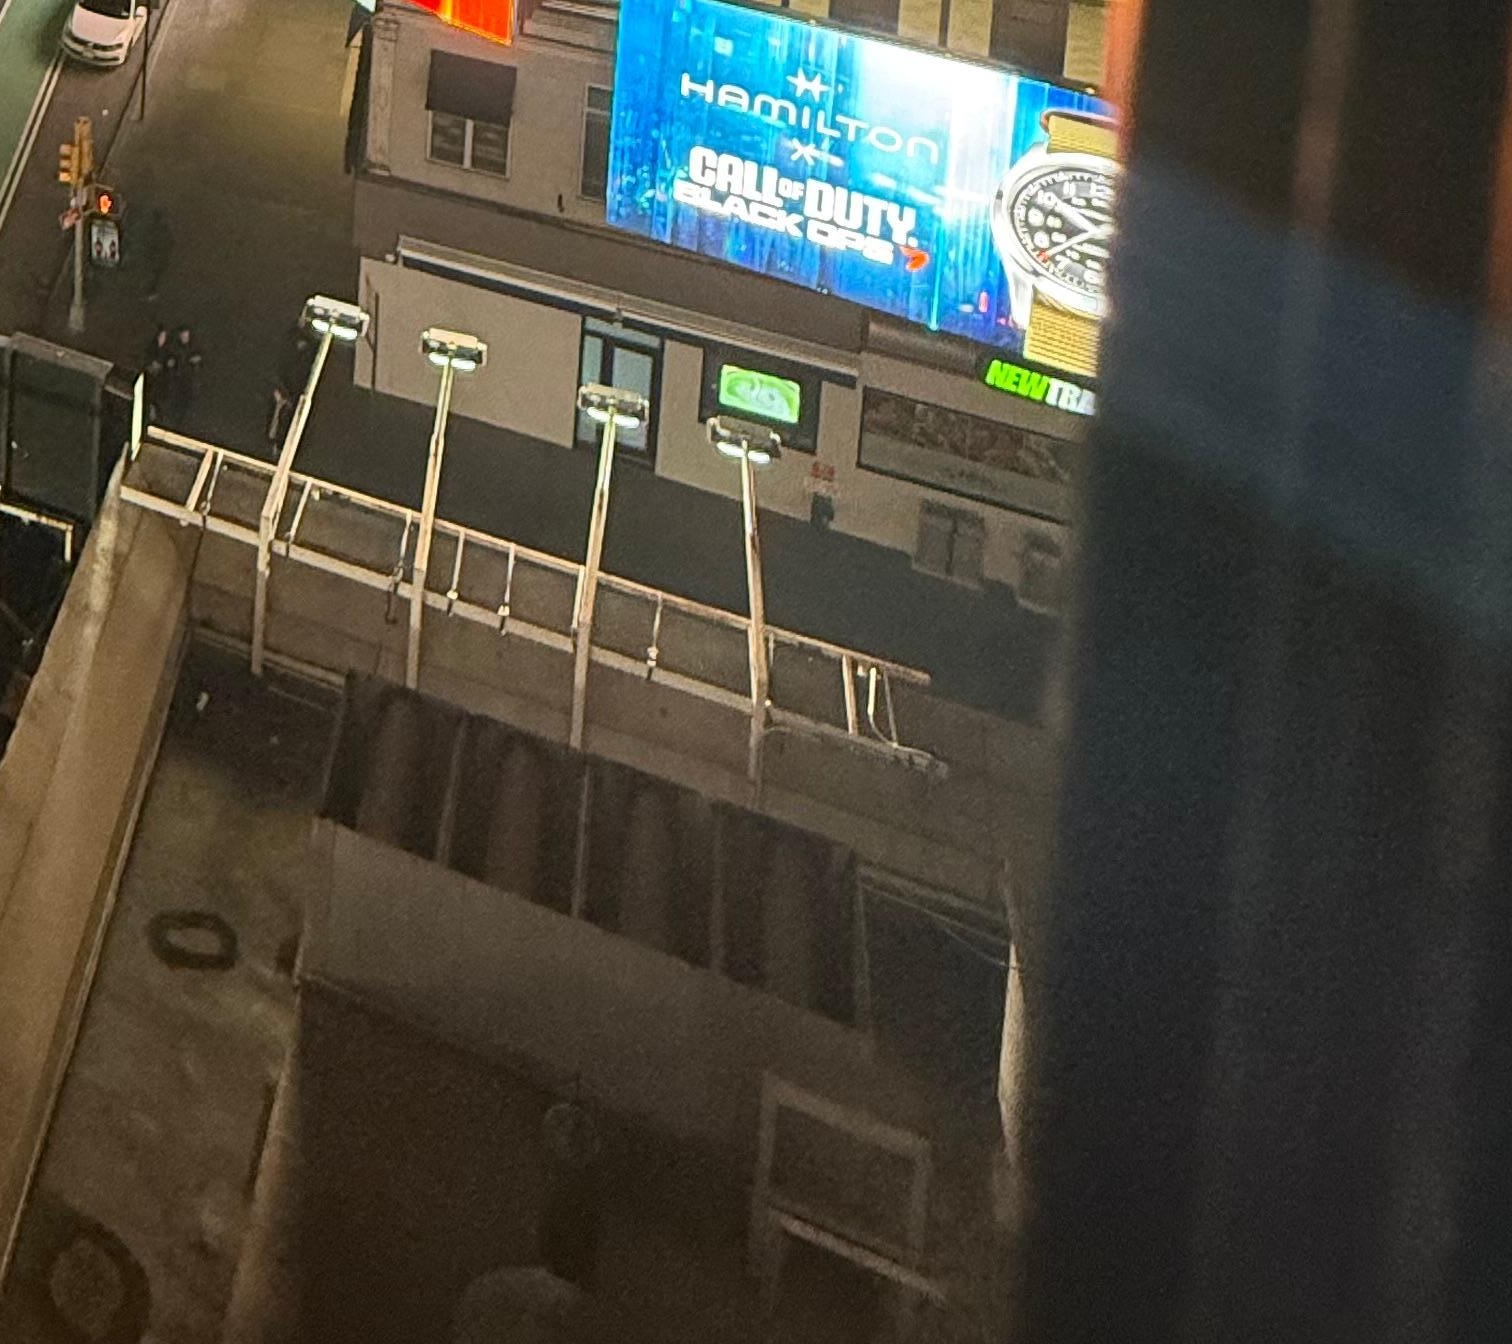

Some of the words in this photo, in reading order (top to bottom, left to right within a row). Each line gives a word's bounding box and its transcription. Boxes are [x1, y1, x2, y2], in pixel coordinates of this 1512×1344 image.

[680, 72, 939, 166] HAMILTON
[689, 145, 783, 207] CALL
[779, 177, 805, 201] OF
[674, 180, 803, 239] BLACK
[806, 221, 894, 265] OPS
